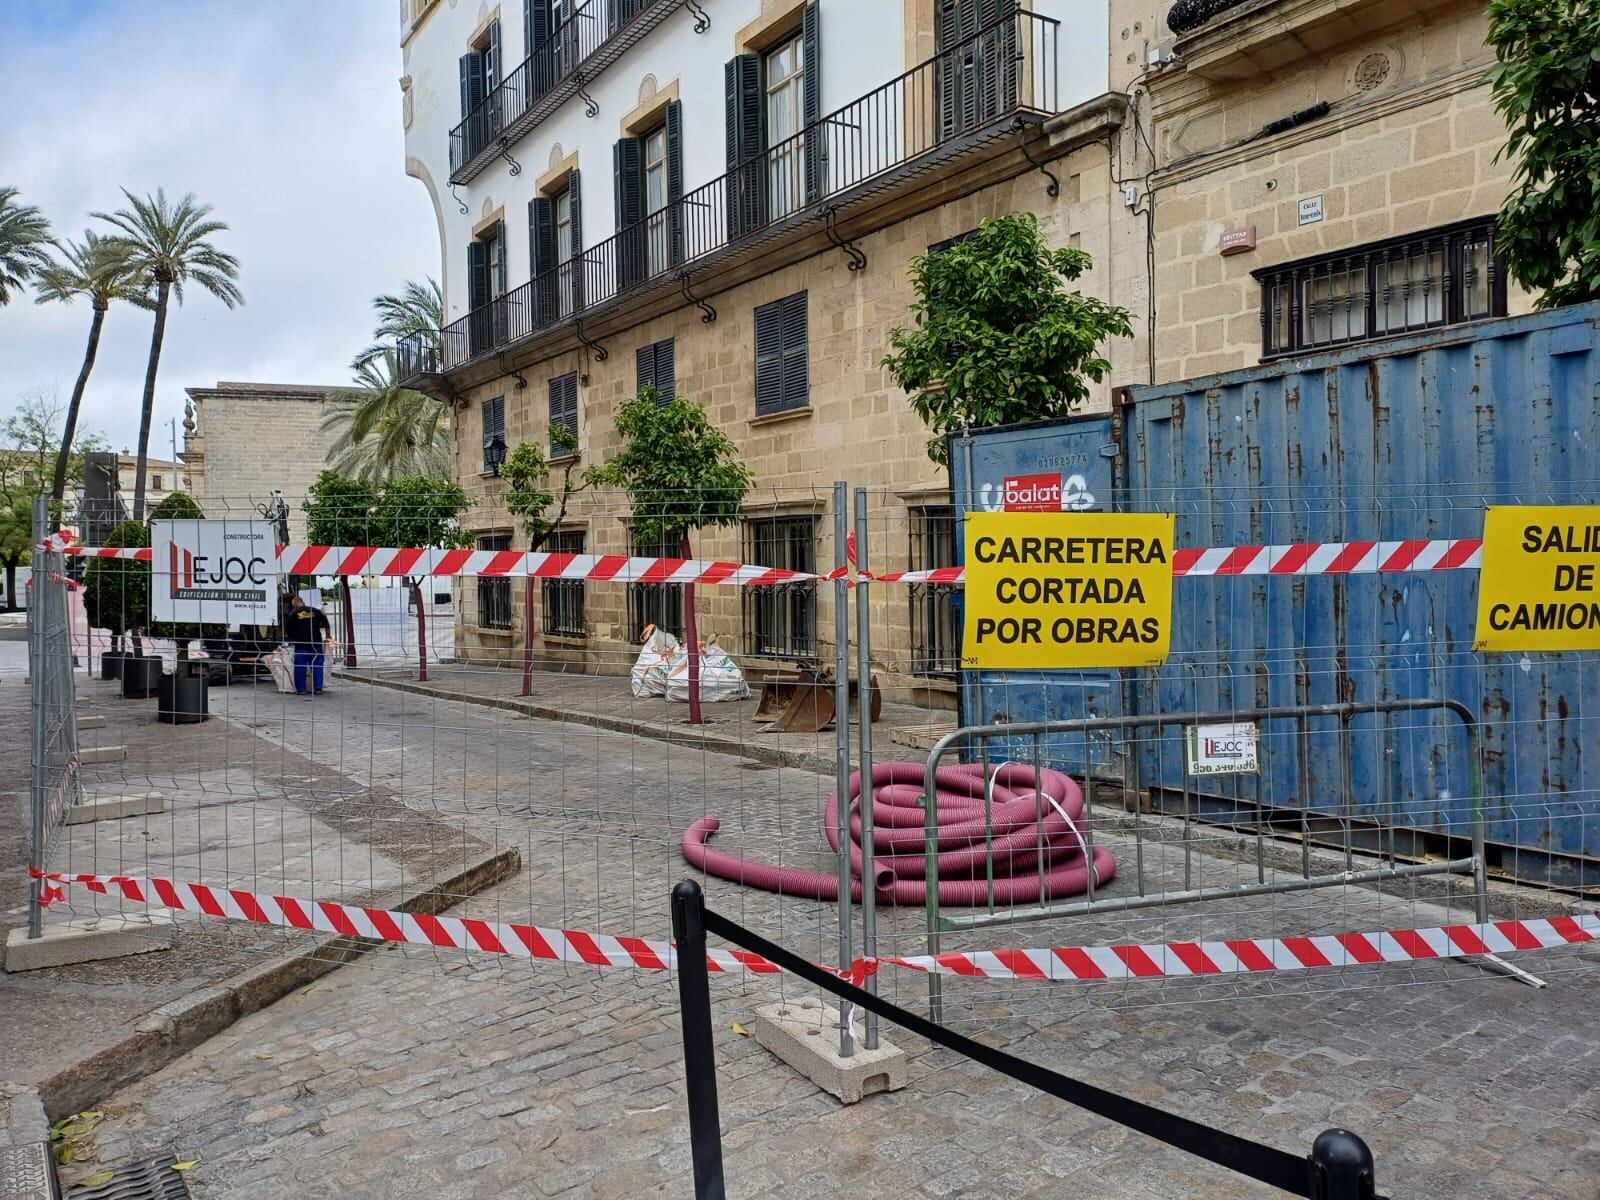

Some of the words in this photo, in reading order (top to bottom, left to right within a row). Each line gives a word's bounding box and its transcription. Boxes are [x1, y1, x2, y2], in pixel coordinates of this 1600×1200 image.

[1006, 480, 1059, 503] balat
[974, 536, 1167, 565] CARRETERA
[193, 556, 266, 585] EJOC
[1554, 564, 1595, 592] DE
[996, 577, 1146, 605] CORTADA
[976, 618, 1042, 644] POR
[1051, 617, 1160, 644] OBRAS
